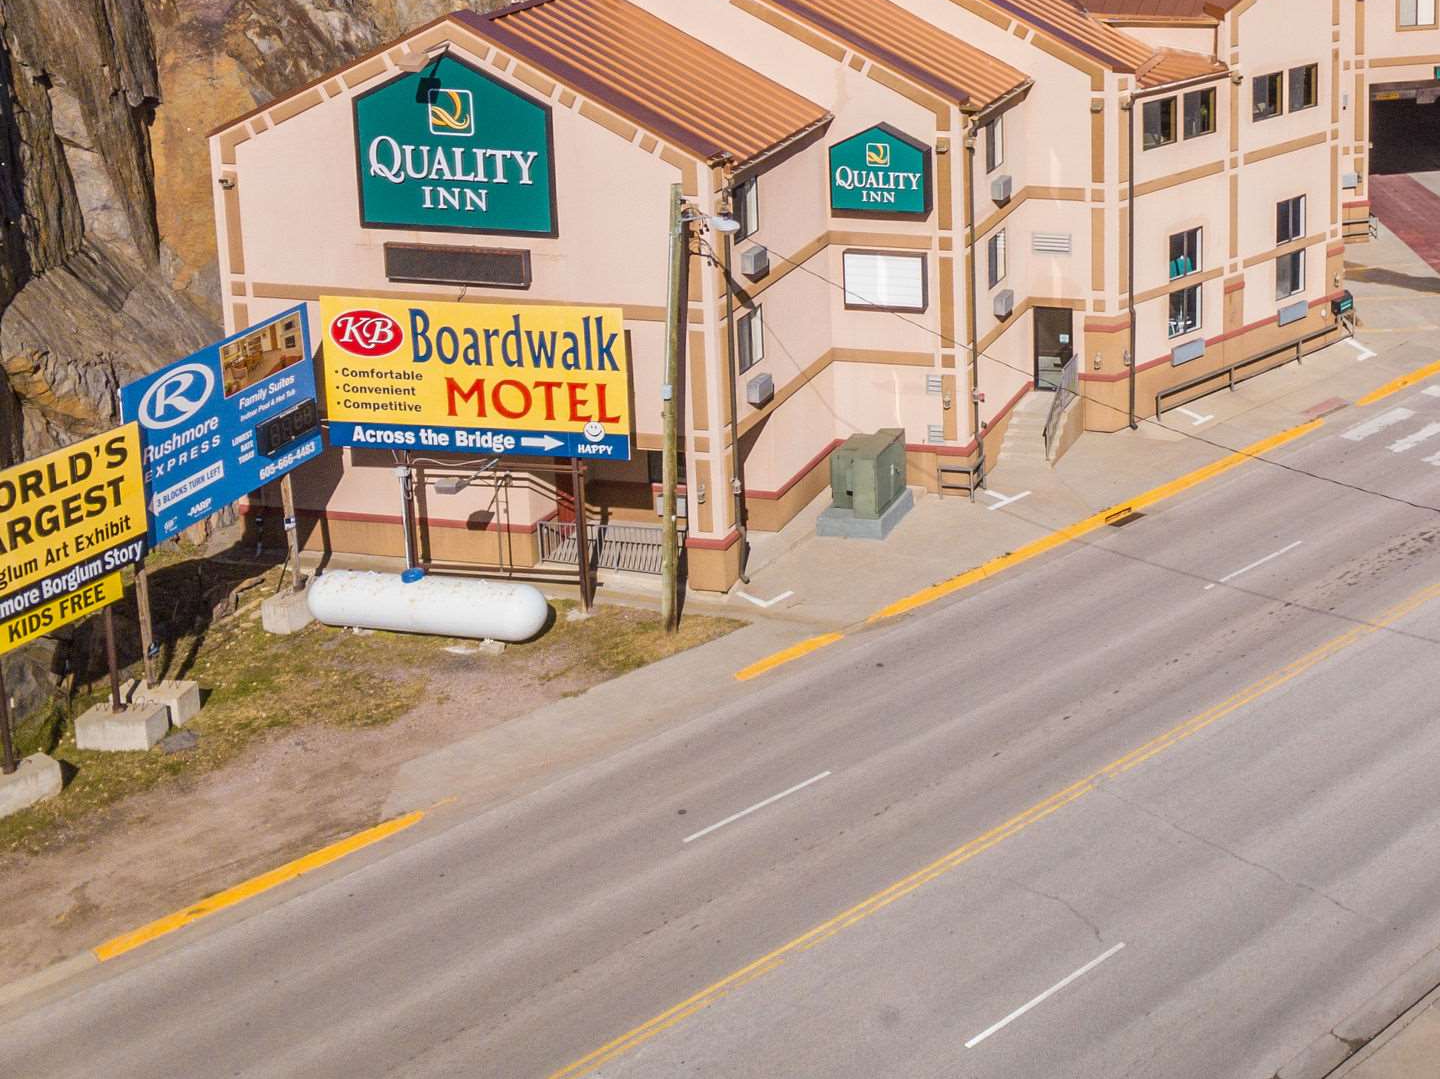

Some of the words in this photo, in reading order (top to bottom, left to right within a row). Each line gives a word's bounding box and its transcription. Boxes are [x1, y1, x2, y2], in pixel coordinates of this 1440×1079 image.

[368, 135, 539, 184] QUALITY
[835, 165, 922, 190] QUALITY
[421, 186, 489, 212] INN
[861, 190, 896, 204] INN
[336, 316, 394, 349] KB
[408, 308, 621, 371] Boardwalk
[341, 367, 424, 382] Comfortable
[343, 384, 417, 397] Convenient
[239, 387, 267, 410] Family
[268, 376, 295, 394] Suites
[343, 399, 423, 413] Competitive
[444, 376, 621, 423] MOTEL
[144, 416, 219, 465] Rushmore
[352, 426, 417, 445] Across
[419, 428, 450, 446] the
[455, 430, 516, 452] Bridge
[577, 443, 613, 456] HAPPY
[144, 434, 221, 483] EXPRESS
[163, 484, 188, 503] BLOCKS
[189, 476, 206, 490] TURN
[206, 466, 221, 480] LEFT
[45, 540, 70, 568] Art
[75, 514, 132, 554] Exhibit
[42, 558, 102, 600] Borglum
[104, 540, 143, 572] Story
[8, 607, 53, 643] KIDS
[59, 583, 106, 619] FREE
